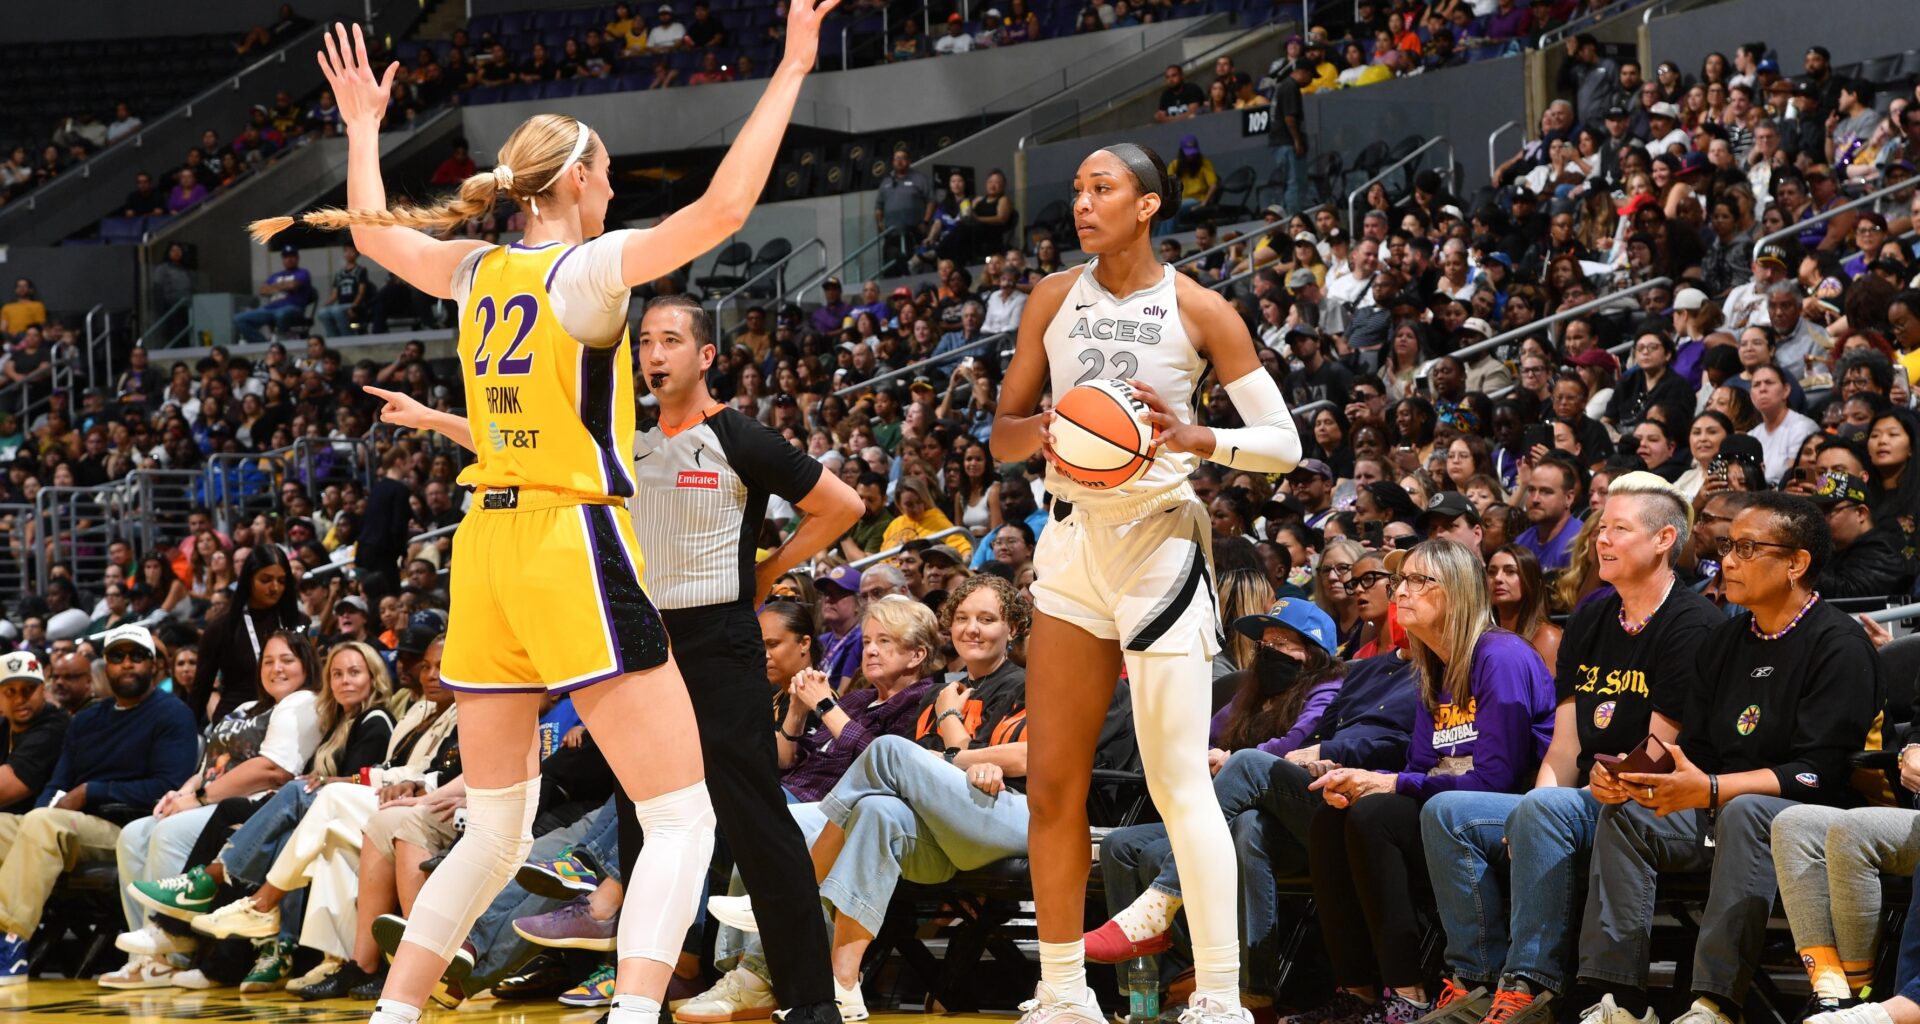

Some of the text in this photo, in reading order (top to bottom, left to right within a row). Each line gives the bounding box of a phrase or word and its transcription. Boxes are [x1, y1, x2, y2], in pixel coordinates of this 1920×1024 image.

[1248, 111, 1269, 133] 109
[1143, 305, 1168, 320] ally
[474, 293, 538, 377] 22
[1068, 317, 1163, 345] ACES
[1073, 348, 1139, 387] 22
[485, 386, 523, 414] BRINK
[499, 429, 540, 449] T&T
[677, 474, 718, 485] Emirates
